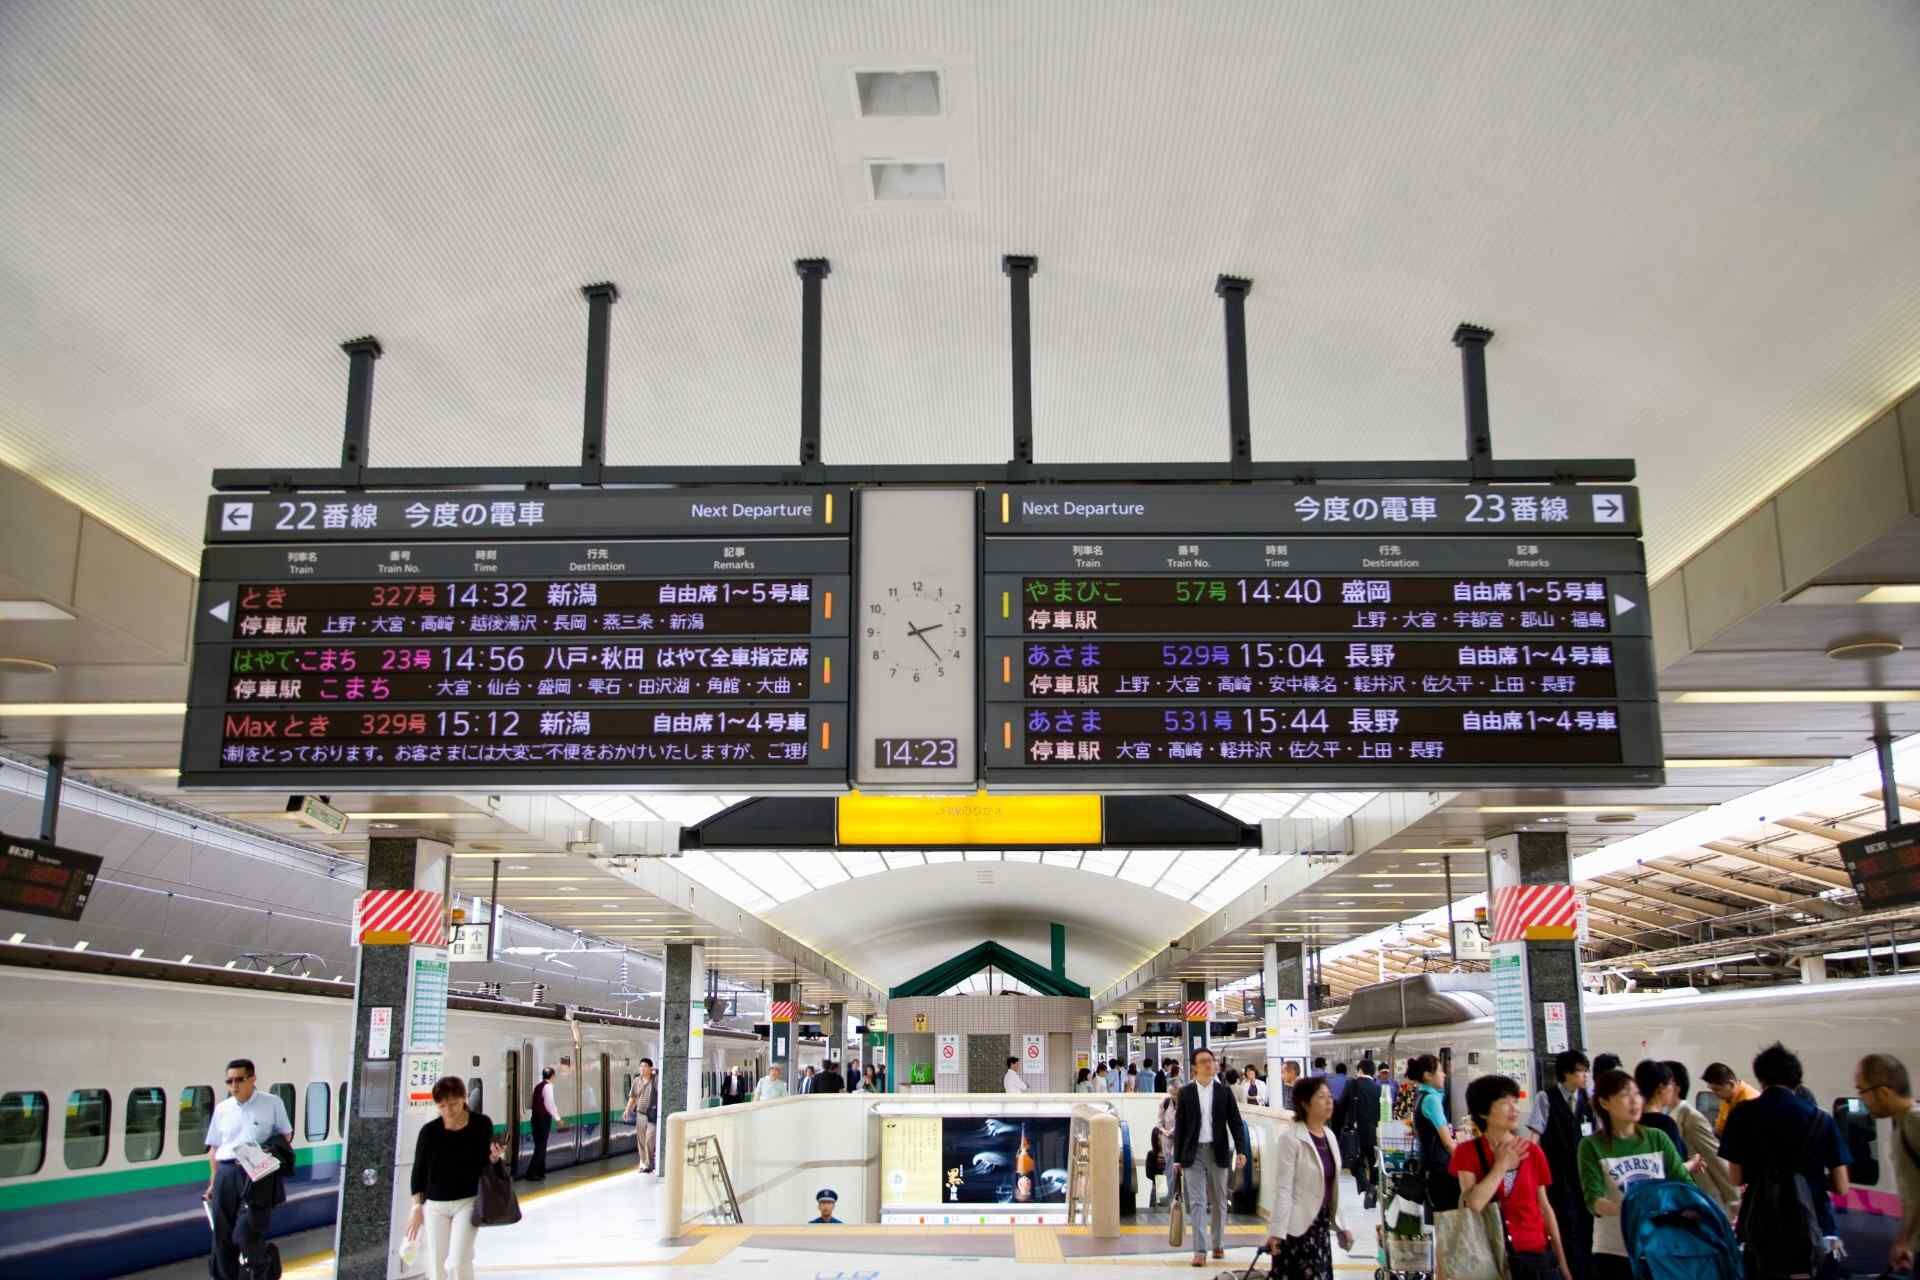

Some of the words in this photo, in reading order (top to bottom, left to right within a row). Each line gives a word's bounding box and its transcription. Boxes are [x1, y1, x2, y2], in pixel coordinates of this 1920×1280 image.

[692, 504, 727, 517] Next
[733, 504, 811, 519] Departure
[1023, 502, 1059, 515] Next
[1064, 502, 1144, 517] Departure
[1295, 496, 1437, 521] 今度の電車
[1465, 495, 1568, 522] 23番線
[276, 502, 377, 529] 22番線
[405, 501, 544, 527] 今度の電車
[378, 564, 402, 573] Train
[404, 564, 419, 573] No.
[474, 563, 498, 571] Time
[569, 561, 625, 571] Destination
[714, 560, 754, 569] Remarks
[1076, 558, 1100, 567] Train
[1168, 559, 1191, 567] Train
[1194, 559, 1209, 567] No.
[1265, 559, 1289, 567] Time
[1363, 559, 1419, 567] Destination
[1508, 559, 1549, 567] Remarks
[290, 565, 313, 574] Train
[888, 586, 899, 597] 11
[911, 581, 923, 592] 12
[937, 586, 943, 597] 1
[1026, 581, 1122, 602] やまびこ
[1177, 582, 1226, 601] 57号
[1238, 580, 1321, 603] 14:40
[1342, 580, 1390, 603] 盛岡
[242, 587, 286, 608] とき
[372, 586, 436, 606] 327号
[448, 583, 527, 607] 14:32
[548, 583, 596, 606] 新潟
[869, 603, 882, 615] 10
[954, 603, 961, 615] 2
[241, 616, 306, 635] 停車駅
[1029, 610, 1097, 629] 停車駅
[866, 626, 874, 638] 9
[959, 626, 967, 638] 3
[383, 650, 431, 669] 23号
[444, 647, 524, 671] 14:56
[657, 647, 808, 667] はやて全車指定席
[872, 649, 880, 661] 8
[953, 649, 961, 660] 4
[1028, 644, 1099, 666] あさま
[1164, 646, 1229, 666] 529号
[1241, 644, 1324, 667] 15:04
[1345, 644, 1395, 667] 長野
[889, 667, 896, 679] 7
[912, 671, 920, 683] 6
[937, 665, 944, 678] 5
[234, 680, 301, 698] 停車駅
[320, 677, 389, 699] こまち
[1030, 675, 1099, 694] 停車駅
[227, 716, 276, 736] Max
[285, 715, 329, 736] とき
[362, 714, 426, 734] 329号
[438, 711, 519, 736] 15:12
[540, 712, 590, 735] 新潟
[1029, 710, 1100, 732] あさま
[1165, 711, 1232, 731] 531号
[1244, 709, 1328, 733] 15:44
[1349, 709, 1399, 732] 長野
[883, 740, 955, 765] 14:23
[1030, 741, 1100, 760] 停車駅
